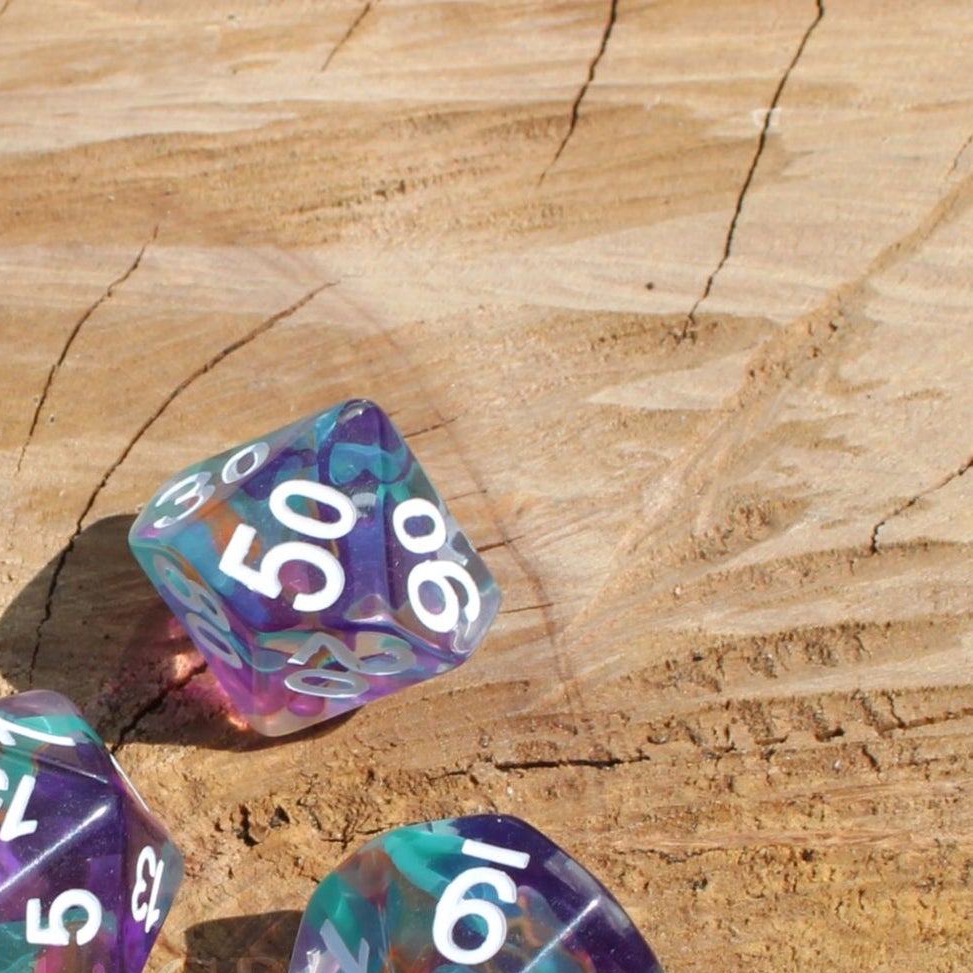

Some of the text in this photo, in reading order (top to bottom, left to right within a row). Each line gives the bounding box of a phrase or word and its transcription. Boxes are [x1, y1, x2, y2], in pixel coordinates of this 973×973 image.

[153, 441, 270, 528] 30
[219, 479, 357, 612] 50
[27, 888, 102, 946] 5
